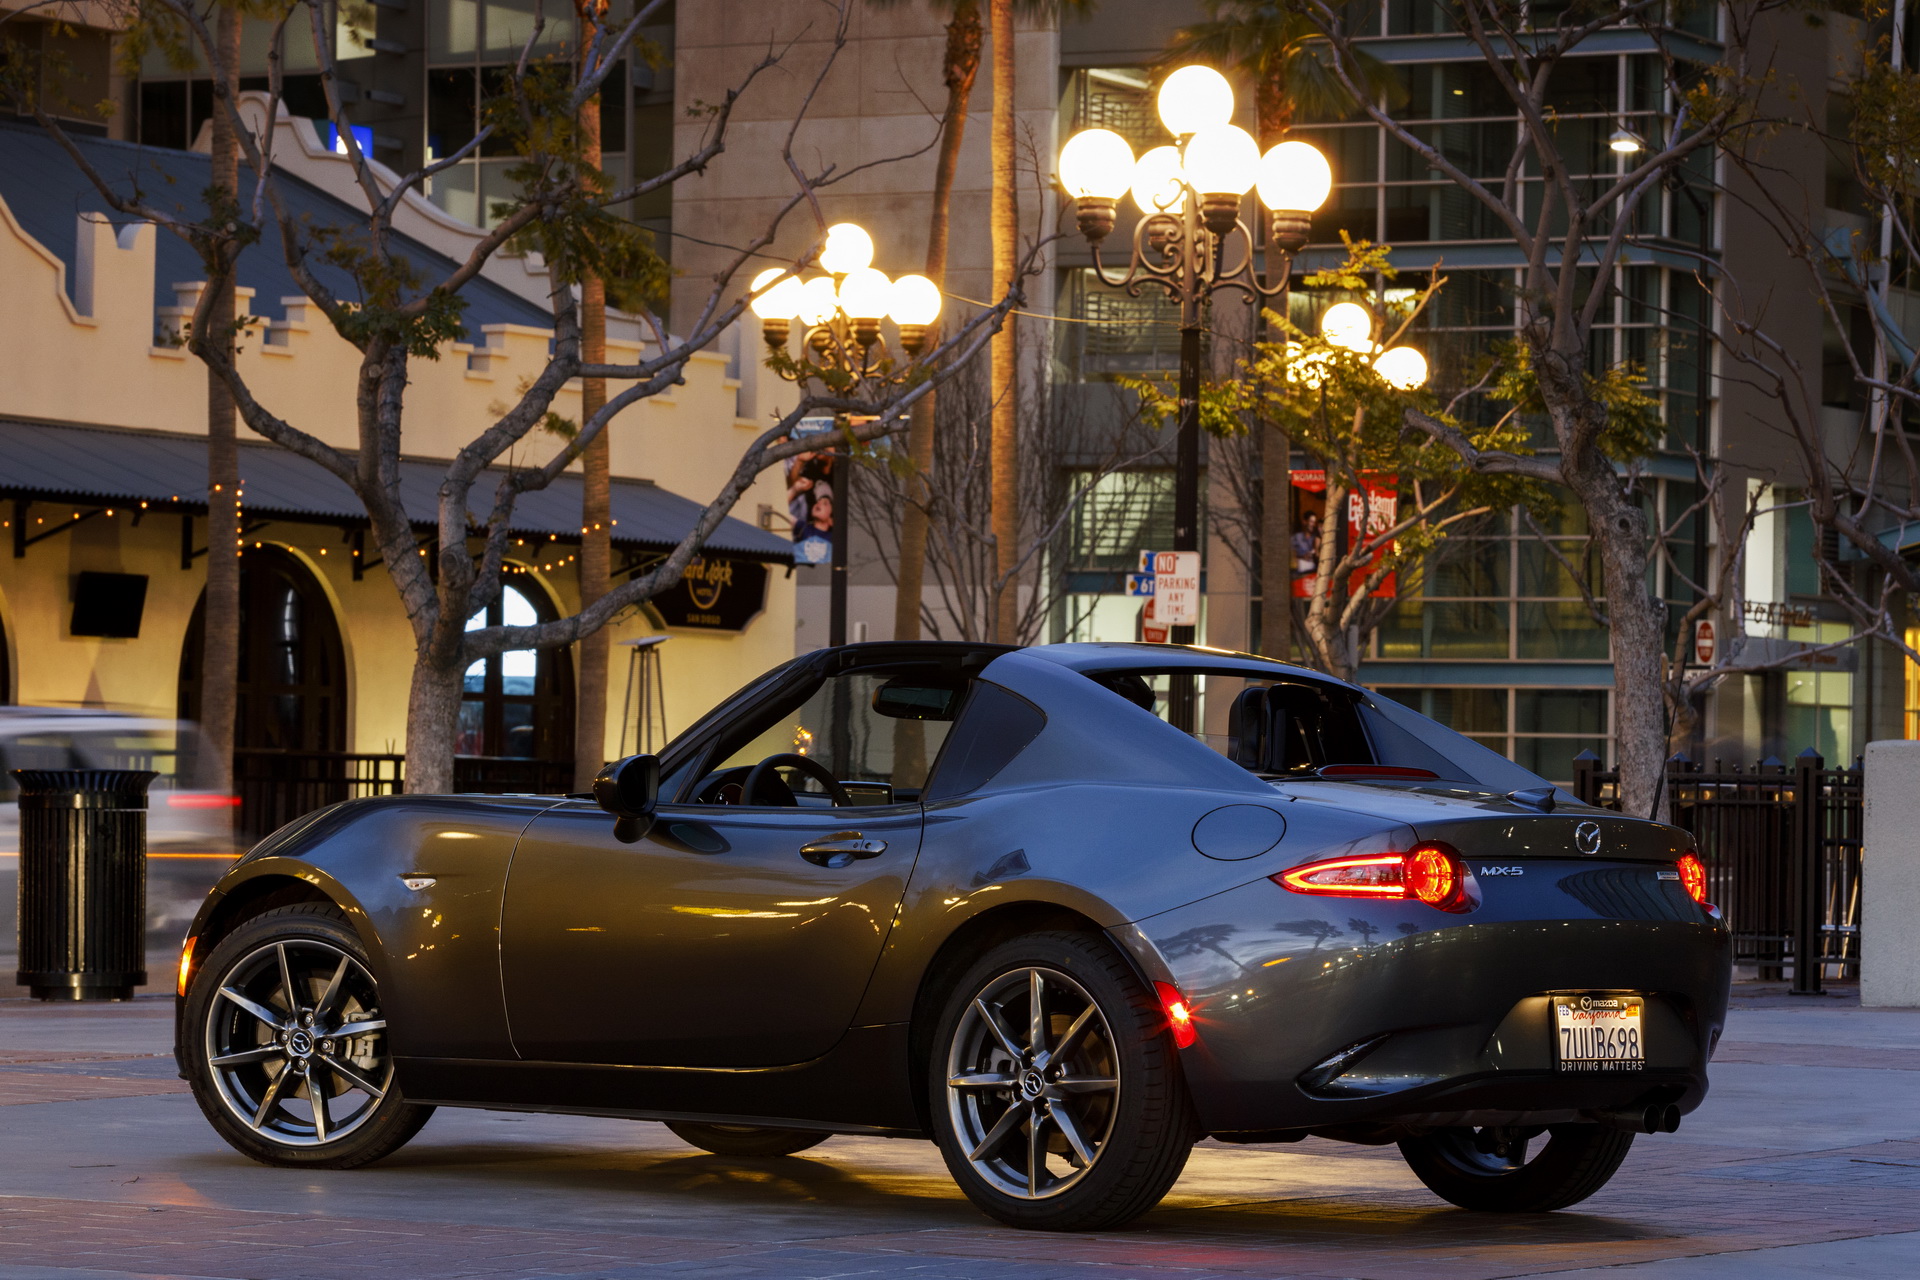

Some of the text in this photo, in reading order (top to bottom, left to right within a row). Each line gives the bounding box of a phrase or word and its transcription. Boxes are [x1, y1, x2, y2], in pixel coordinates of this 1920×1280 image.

[682, 557, 706, 580] ard
[1158, 555, 1174, 572] NO
[1158, 577, 1196, 590] PARKING
[1168, 592, 1185, 603] ANY
[1167, 605, 1185, 616] TIME
[1480, 866, 1524, 876] MX-5
[1572, 1010, 1627, 1025] California
[1561, 1027, 1639, 1058] 7UUB698
[1561, 1061, 1599, 1071] DRIVING
